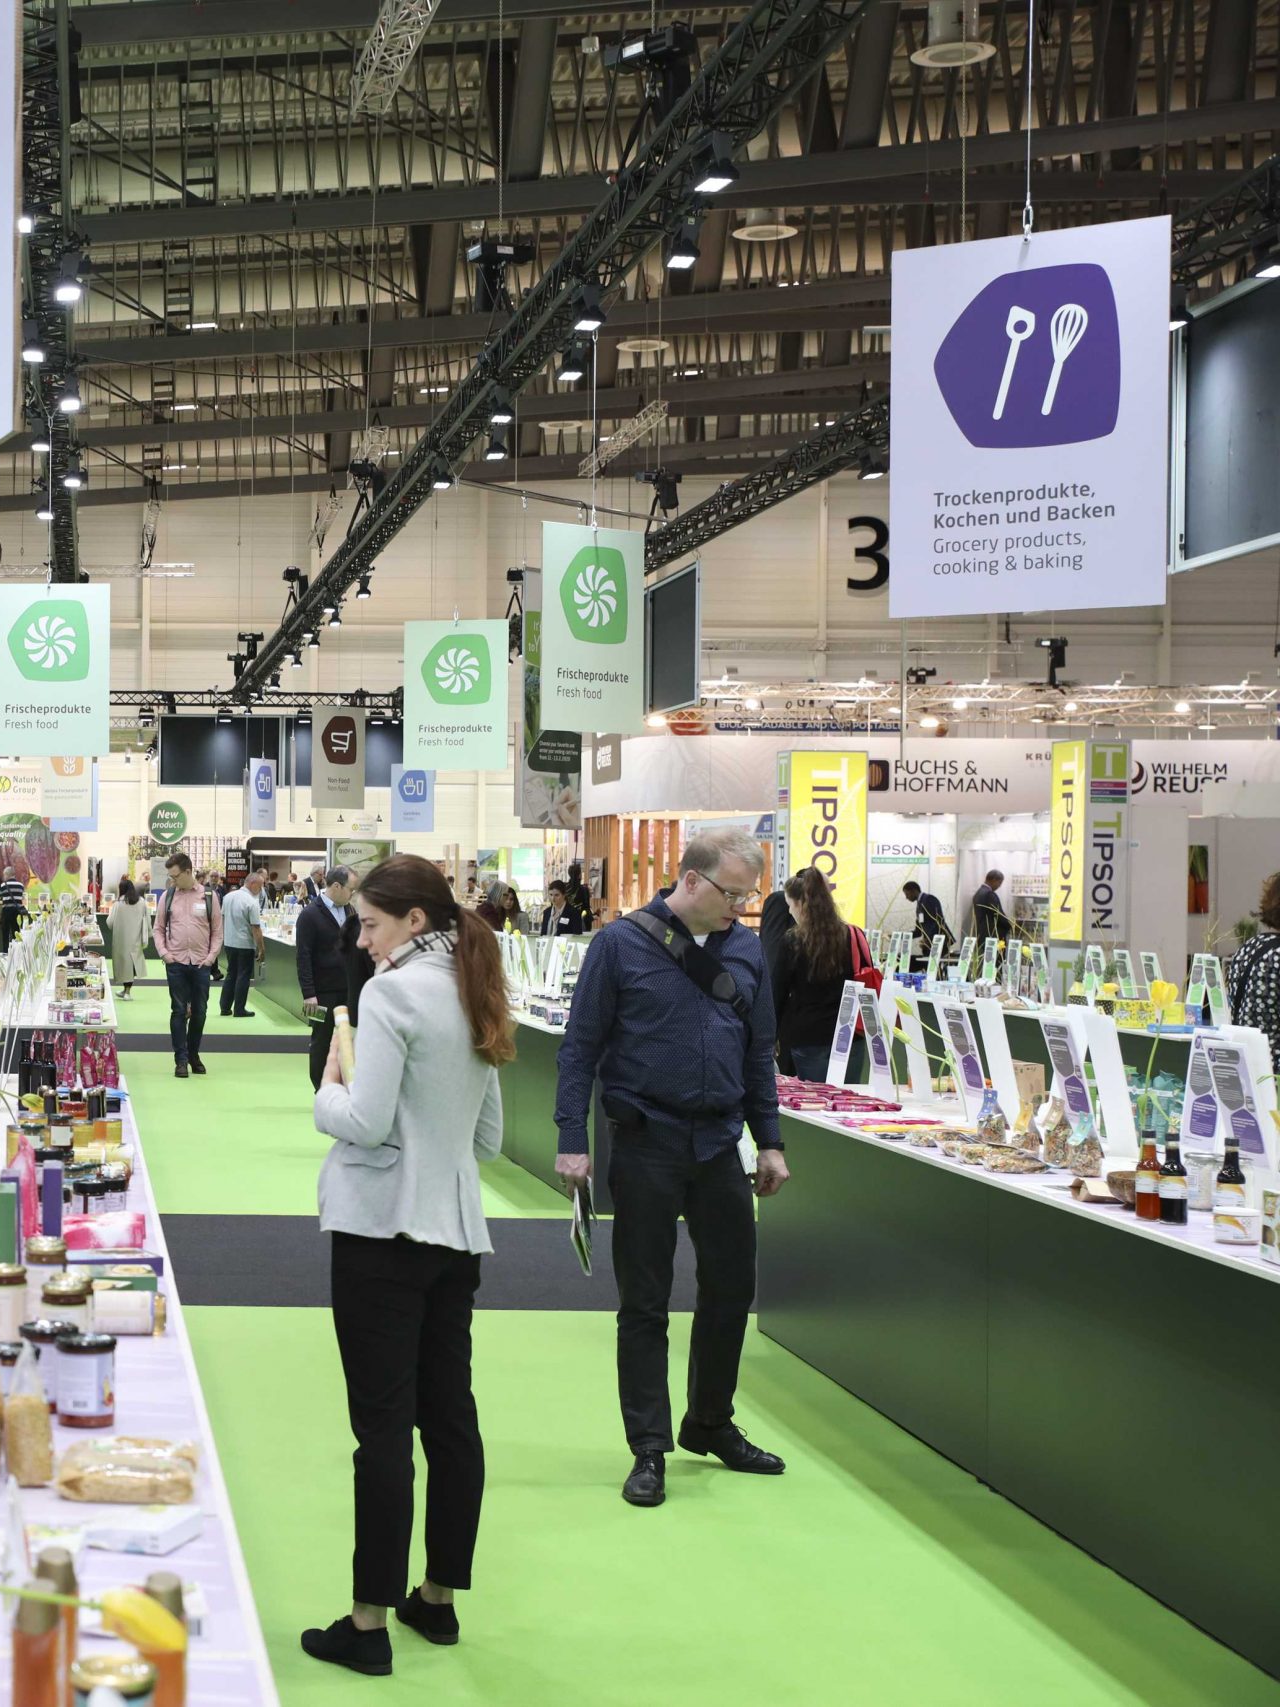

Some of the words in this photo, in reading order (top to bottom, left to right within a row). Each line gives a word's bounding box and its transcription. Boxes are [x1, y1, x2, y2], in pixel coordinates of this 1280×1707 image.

[933, 482, 1096, 508] Trockenprodukte,
[933, 512, 1000, 530] Kochen
[1006, 508, 1041, 526] und
[1047, 503, 1115, 522] Backen
[933, 535, 999, 555] Grocery
[1004, 530, 1087, 553] products,
[847, 515, 890, 591] 3
[933, 558, 999, 578] cooking
[1004, 555, 1018, 572] &
[1023, 551, 1083, 571] baking
[557, 667, 629, 684] Frischeprodukte
[556, 685, 581, 699] Fresh
[583, 687, 602, 700] food
[5, 704, 91, 716] Frischeprodukte
[4, 719, 33, 730] Fresh
[36, 719, 59, 730] food
[418, 723, 493, 736] Frischeprodukte
[418, 736, 442, 747] Fresh
[444, 736, 465, 747] food
[894, 760, 959, 775] FUCHS
[964, 760, 978, 775] &
[1151, 762, 1228, 775] WILHELM
[12, 786, 37, 795] Group
[894, 777, 1009, 793] HOFFMANN
[157, 808, 179, 820] New
[151, 819, 184, 830] products
[811, 757, 849, 894] TIPSO
[1060, 747, 1080, 914] TIPSON
[1091, 811, 1123, 930] TIPSON
